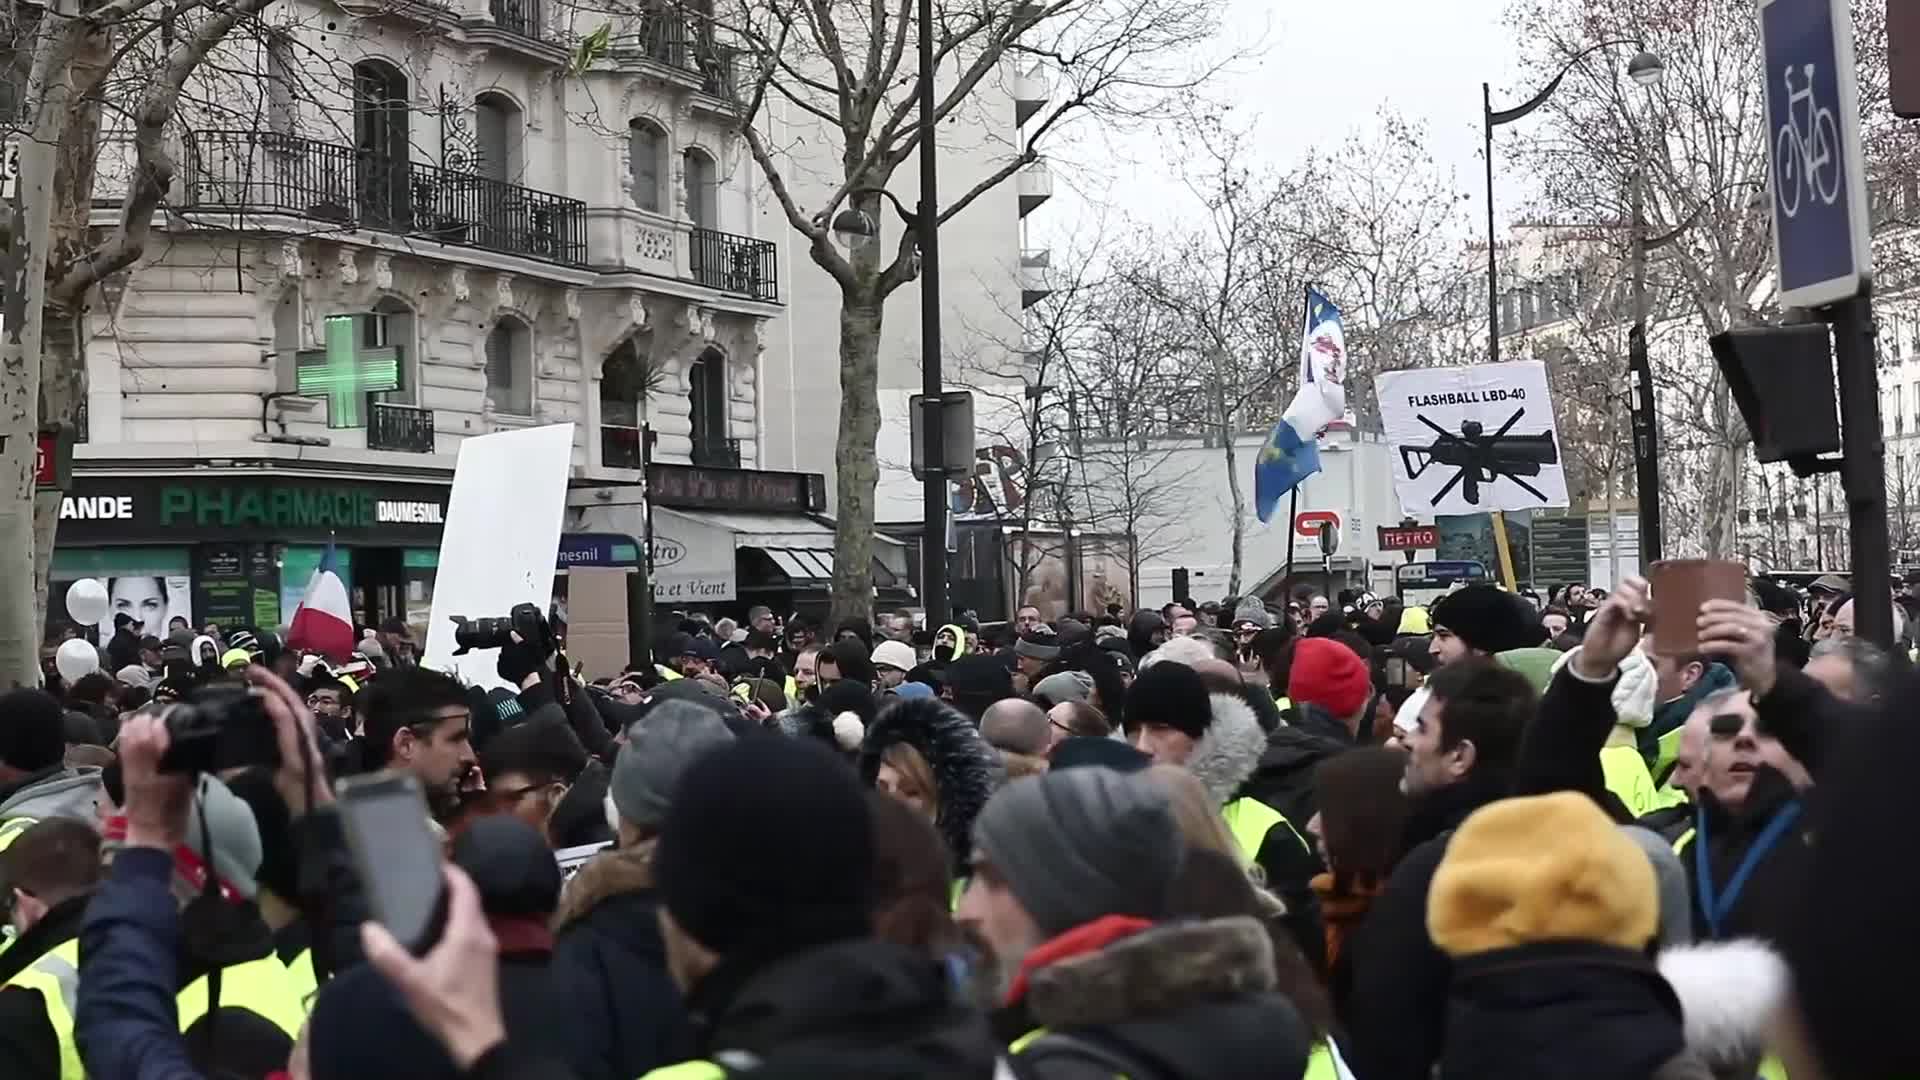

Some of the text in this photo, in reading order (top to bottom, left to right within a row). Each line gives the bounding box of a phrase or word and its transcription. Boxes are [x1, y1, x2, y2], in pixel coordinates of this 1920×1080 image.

[1408, 388, 1526, 407] FLASHBALL LBD-40
[60, 496, 133, 519] ANDE
[160, 487, 444, 528] PHARMACIE DAUMESNIL
[668, 583, 681, 596] et
[687, 579, 726, 595] Vient
